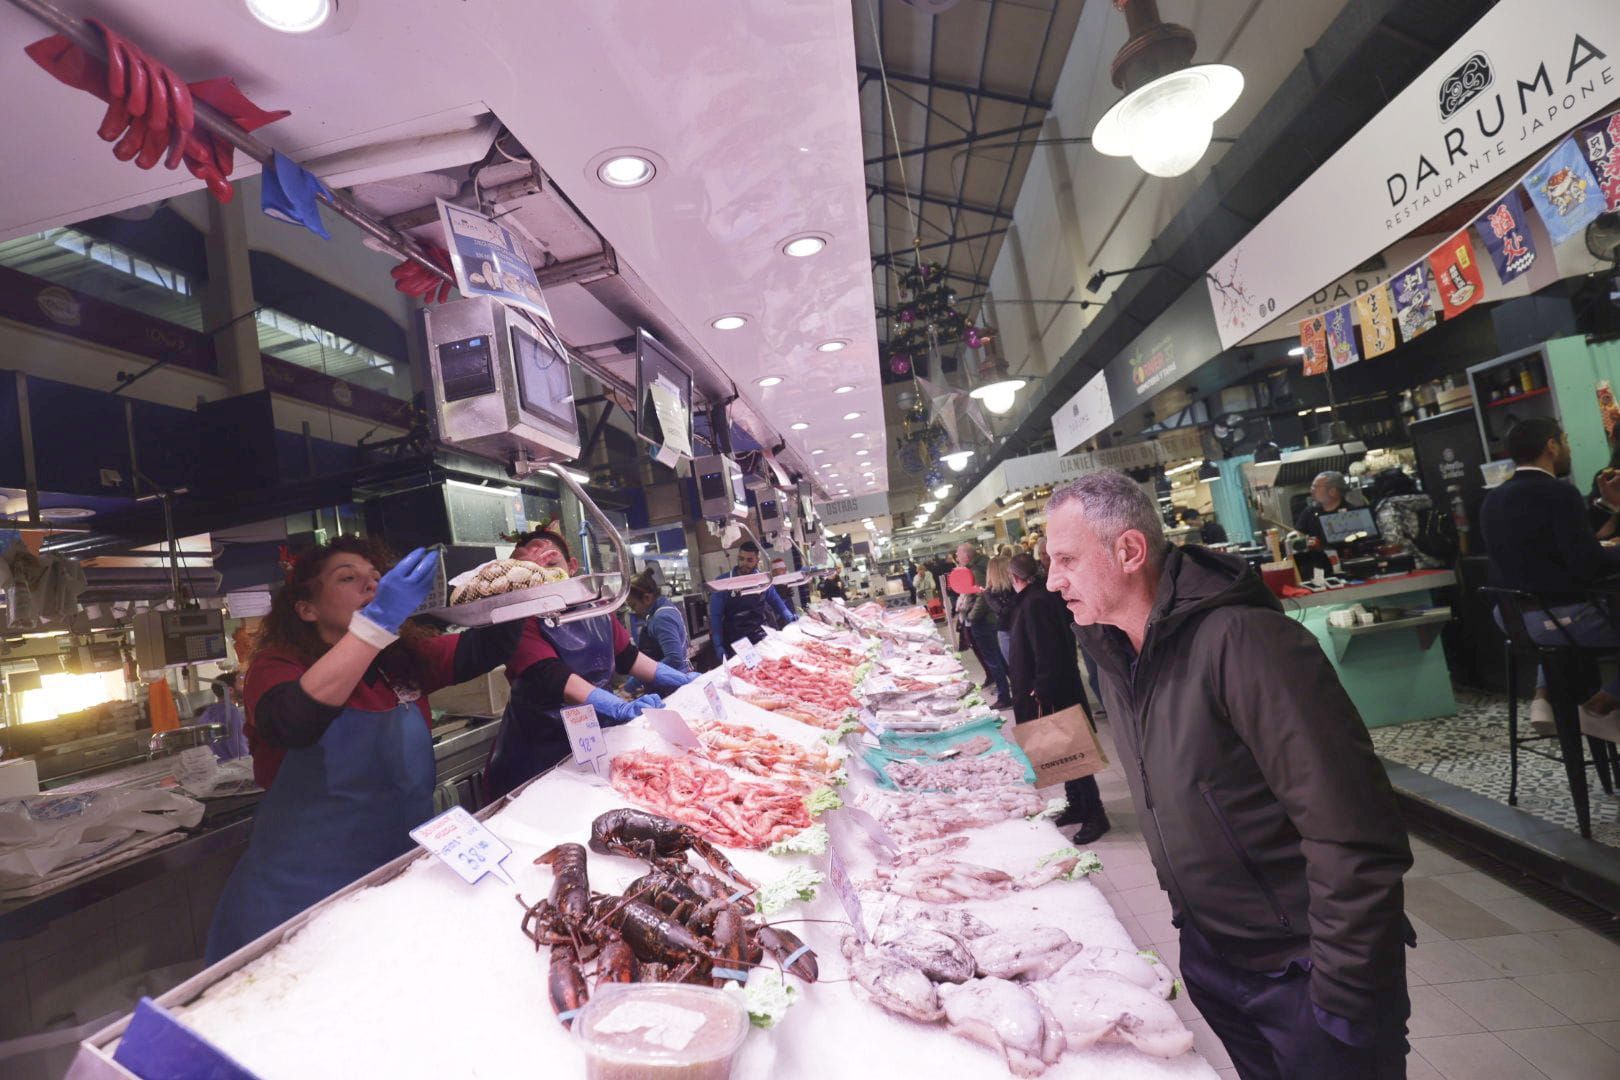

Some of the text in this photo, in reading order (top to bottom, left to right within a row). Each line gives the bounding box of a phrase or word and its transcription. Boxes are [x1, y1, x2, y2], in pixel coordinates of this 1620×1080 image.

[1386, 33, 1608, 208] DARUMA
[1385, 140, 1506, 231] RESTAURANTE
[1059, 454, 1095, 473] DANIEL
[826, 497, 859, 516] OSTRAS
[1040, 754, 1079, 770] CONVERSE
